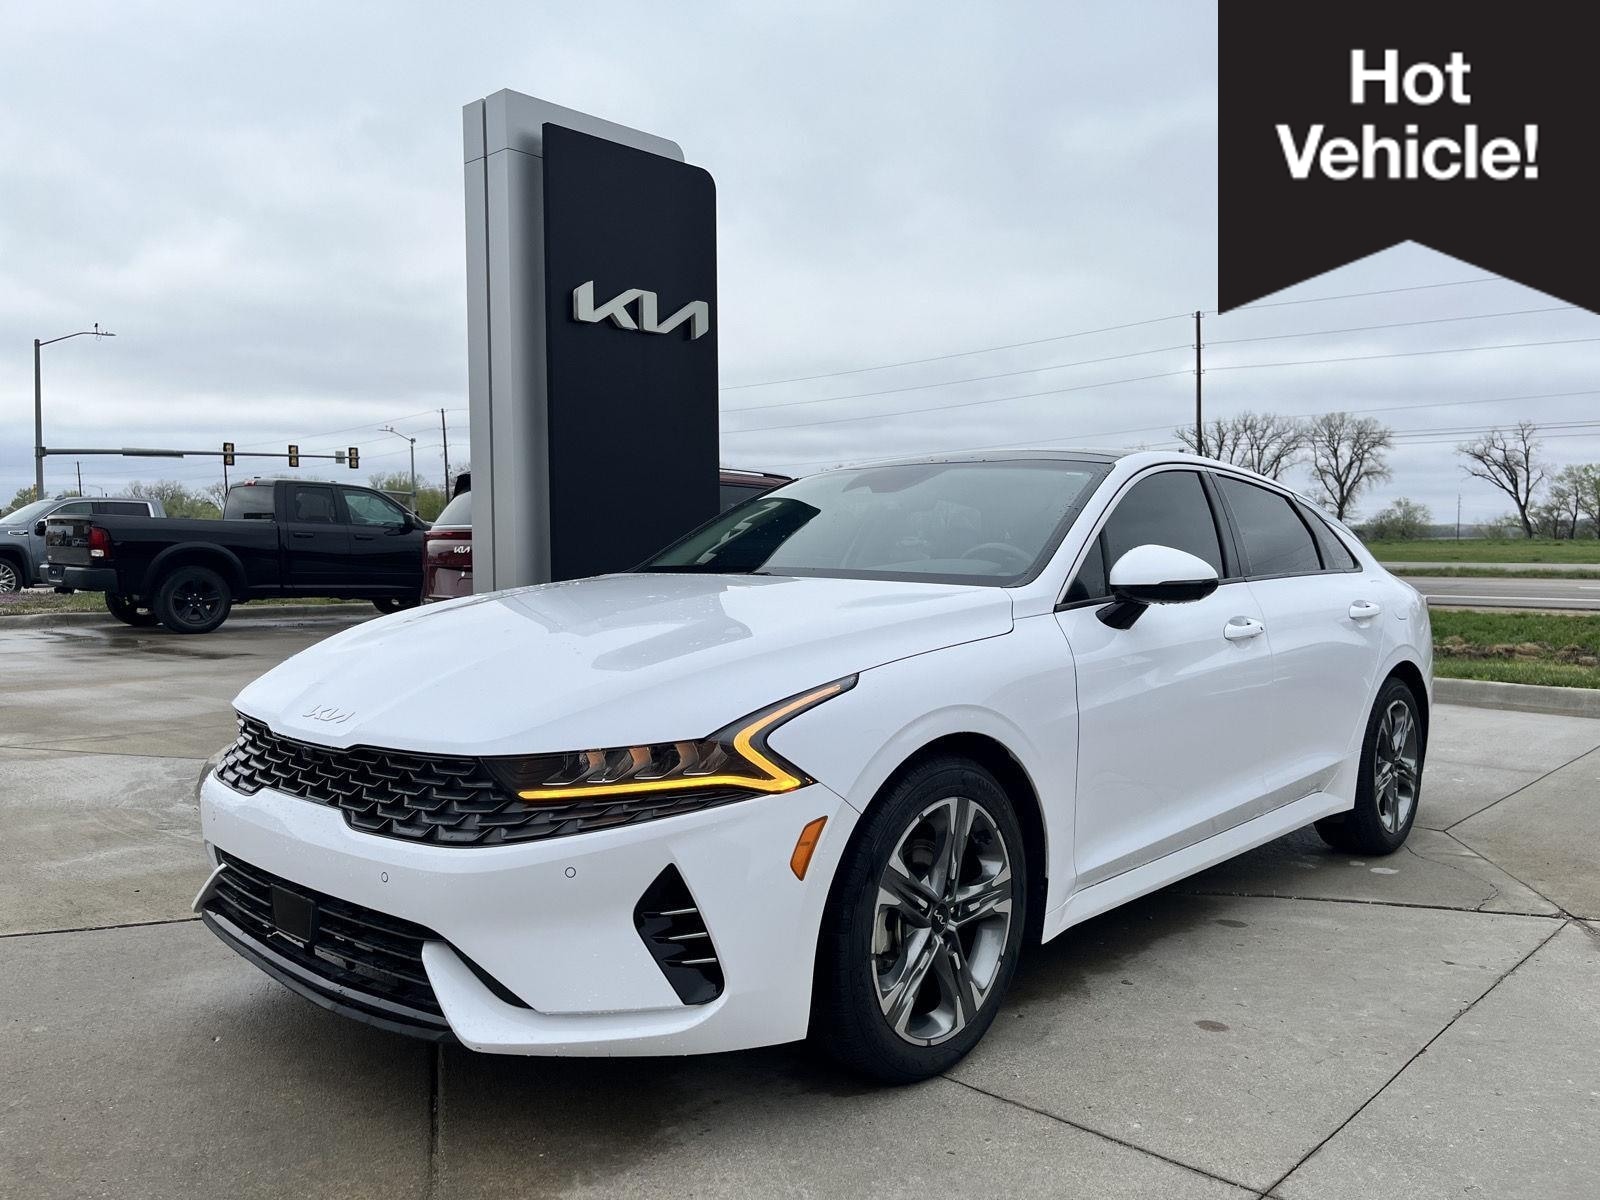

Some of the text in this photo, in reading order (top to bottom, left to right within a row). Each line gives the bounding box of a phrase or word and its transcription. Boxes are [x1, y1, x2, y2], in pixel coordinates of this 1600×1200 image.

[572, 280, 709, 341] KIA
[453, 545, 471, 554] KIA
[302, 704, 356, 724] KIA
